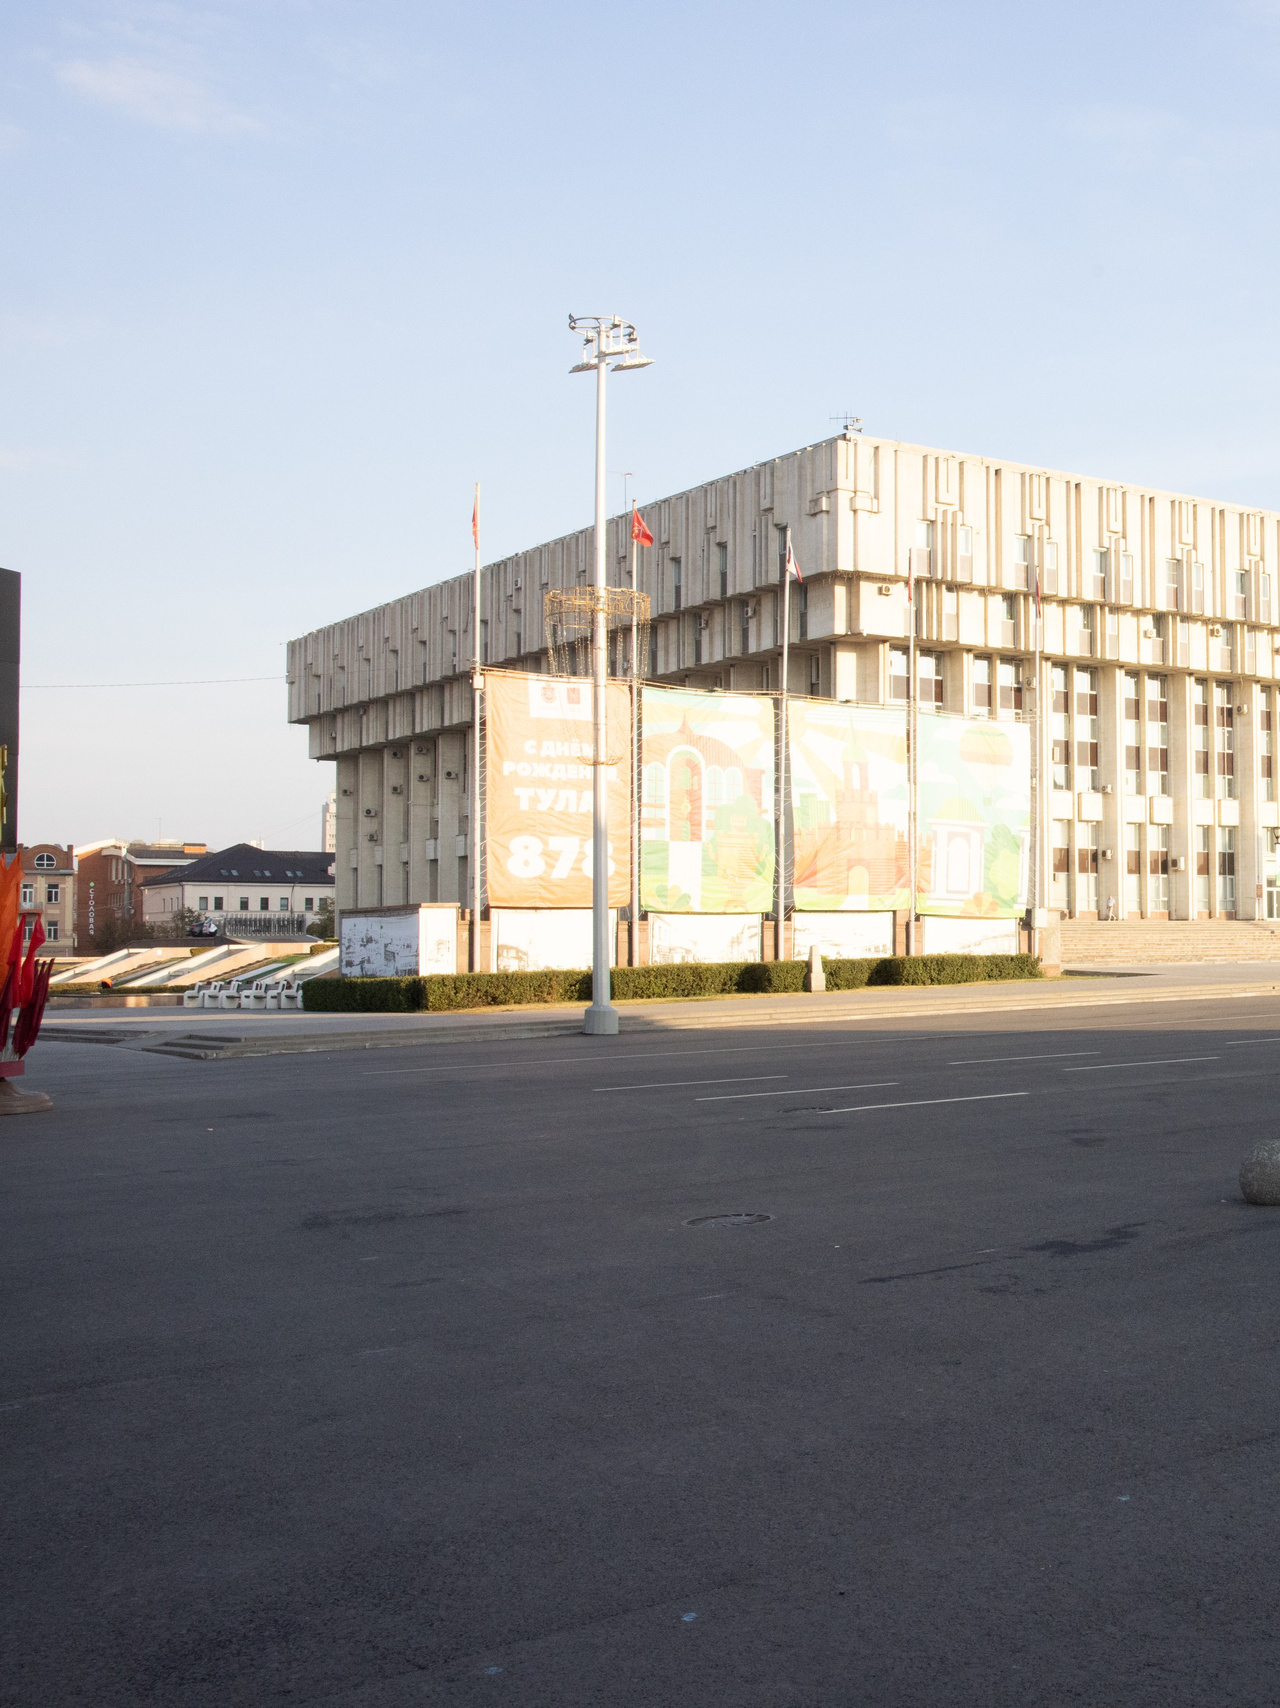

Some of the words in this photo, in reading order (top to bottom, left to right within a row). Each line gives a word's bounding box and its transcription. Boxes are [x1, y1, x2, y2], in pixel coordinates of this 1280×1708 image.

[524, 740, 537, 754] С
[503, 762, 620, 781] РОЖДЕНЯ,
[507, 835, 616, 878] 878
